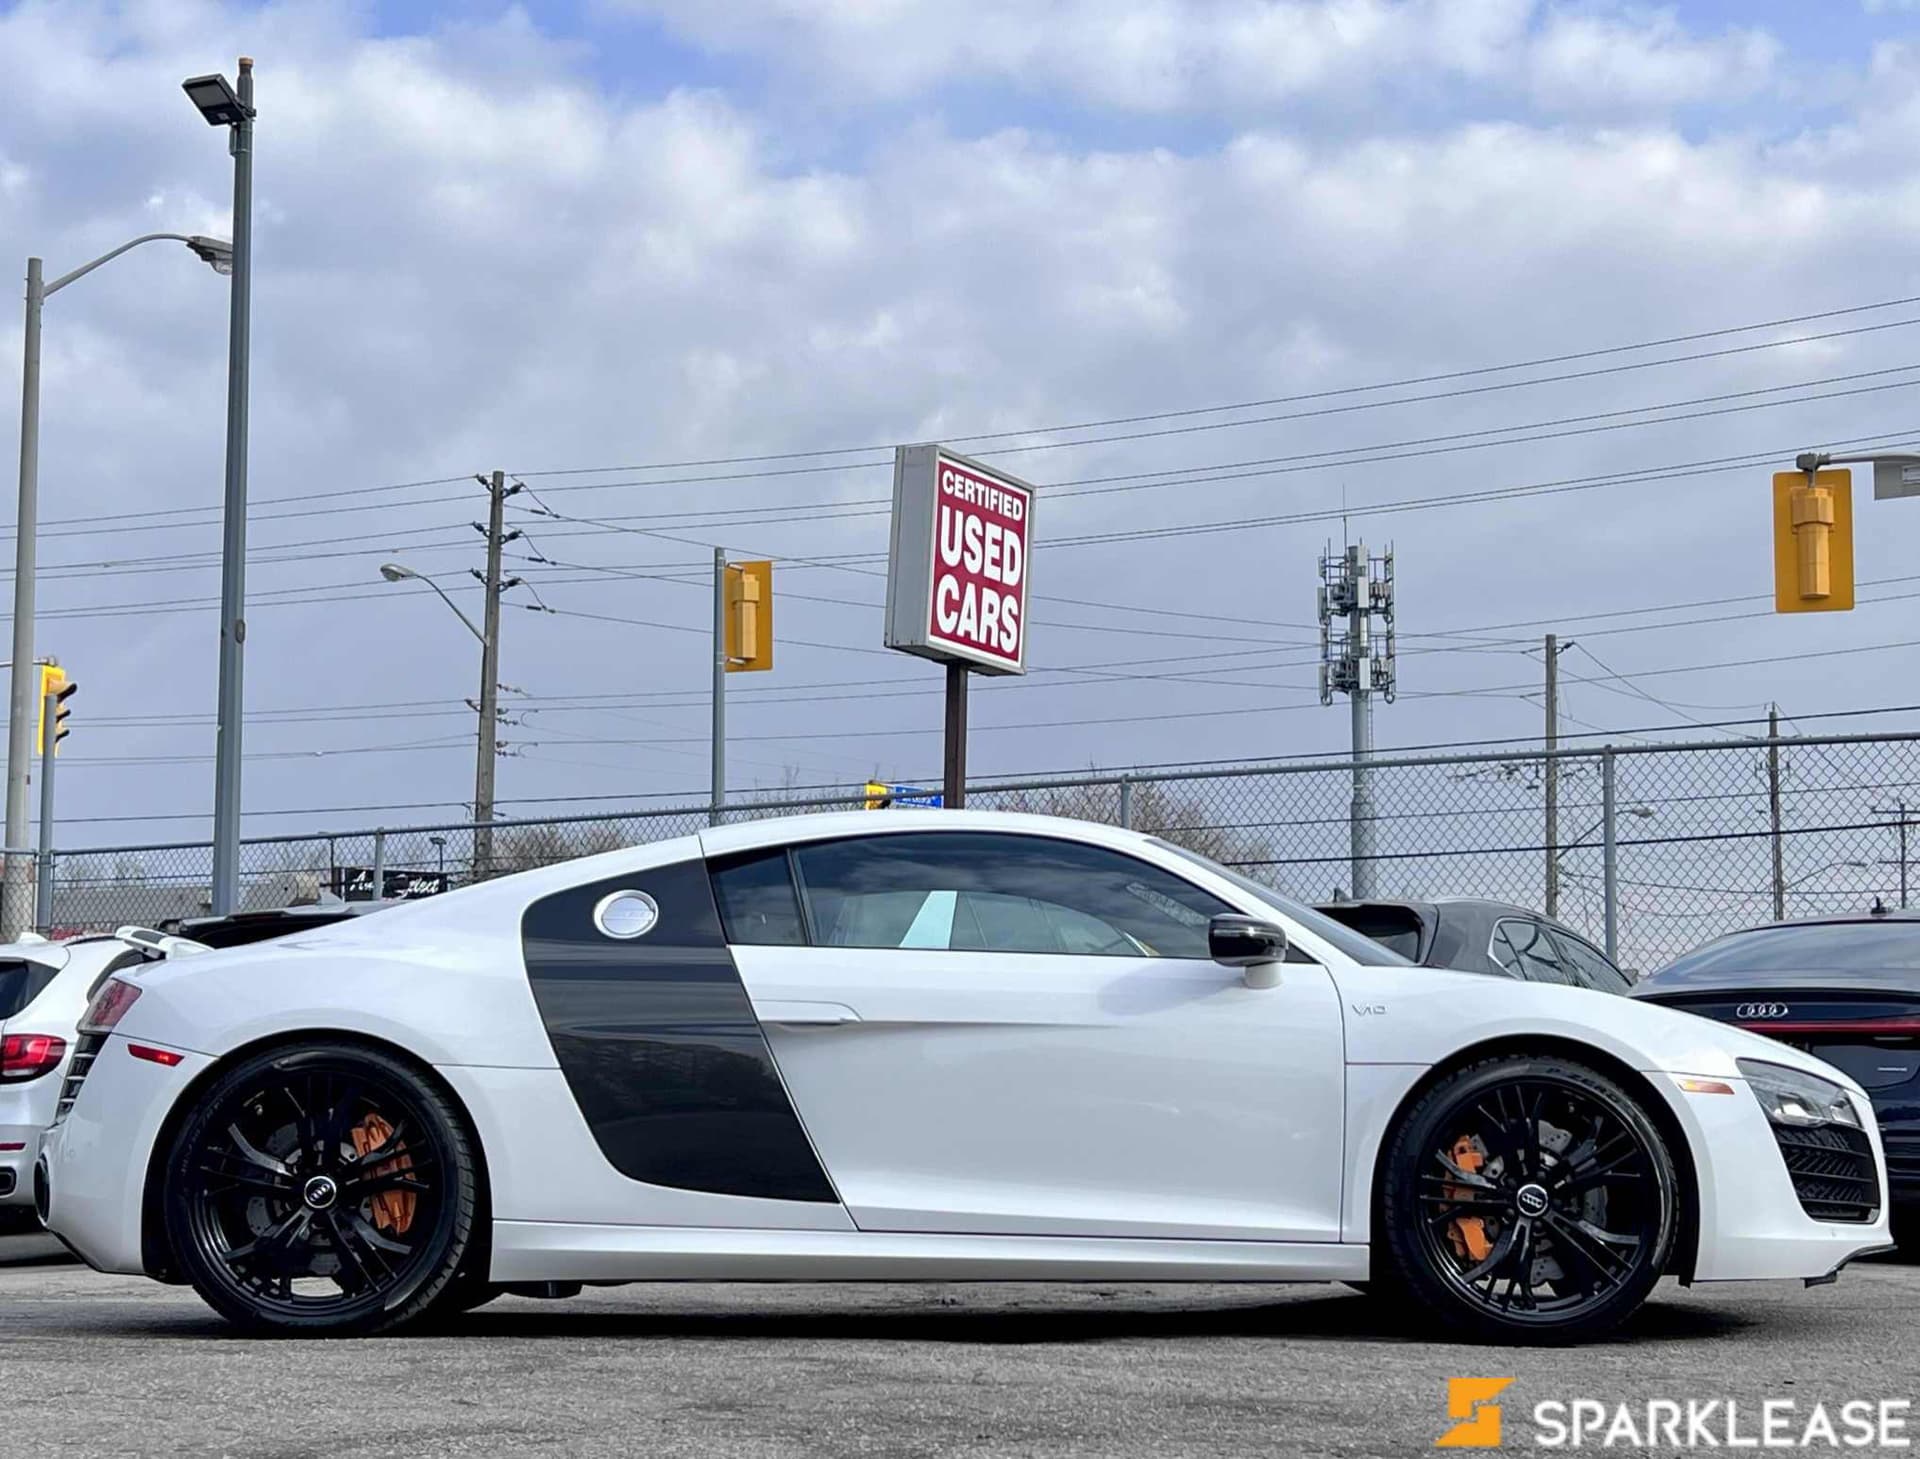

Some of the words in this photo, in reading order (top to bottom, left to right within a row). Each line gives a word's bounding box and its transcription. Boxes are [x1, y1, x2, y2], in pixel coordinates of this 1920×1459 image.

[942, 470, 1023, 521] CERTIFIED
[940, 505, 1022, 586] USED
[936, 574, 1019, 653] CARS
